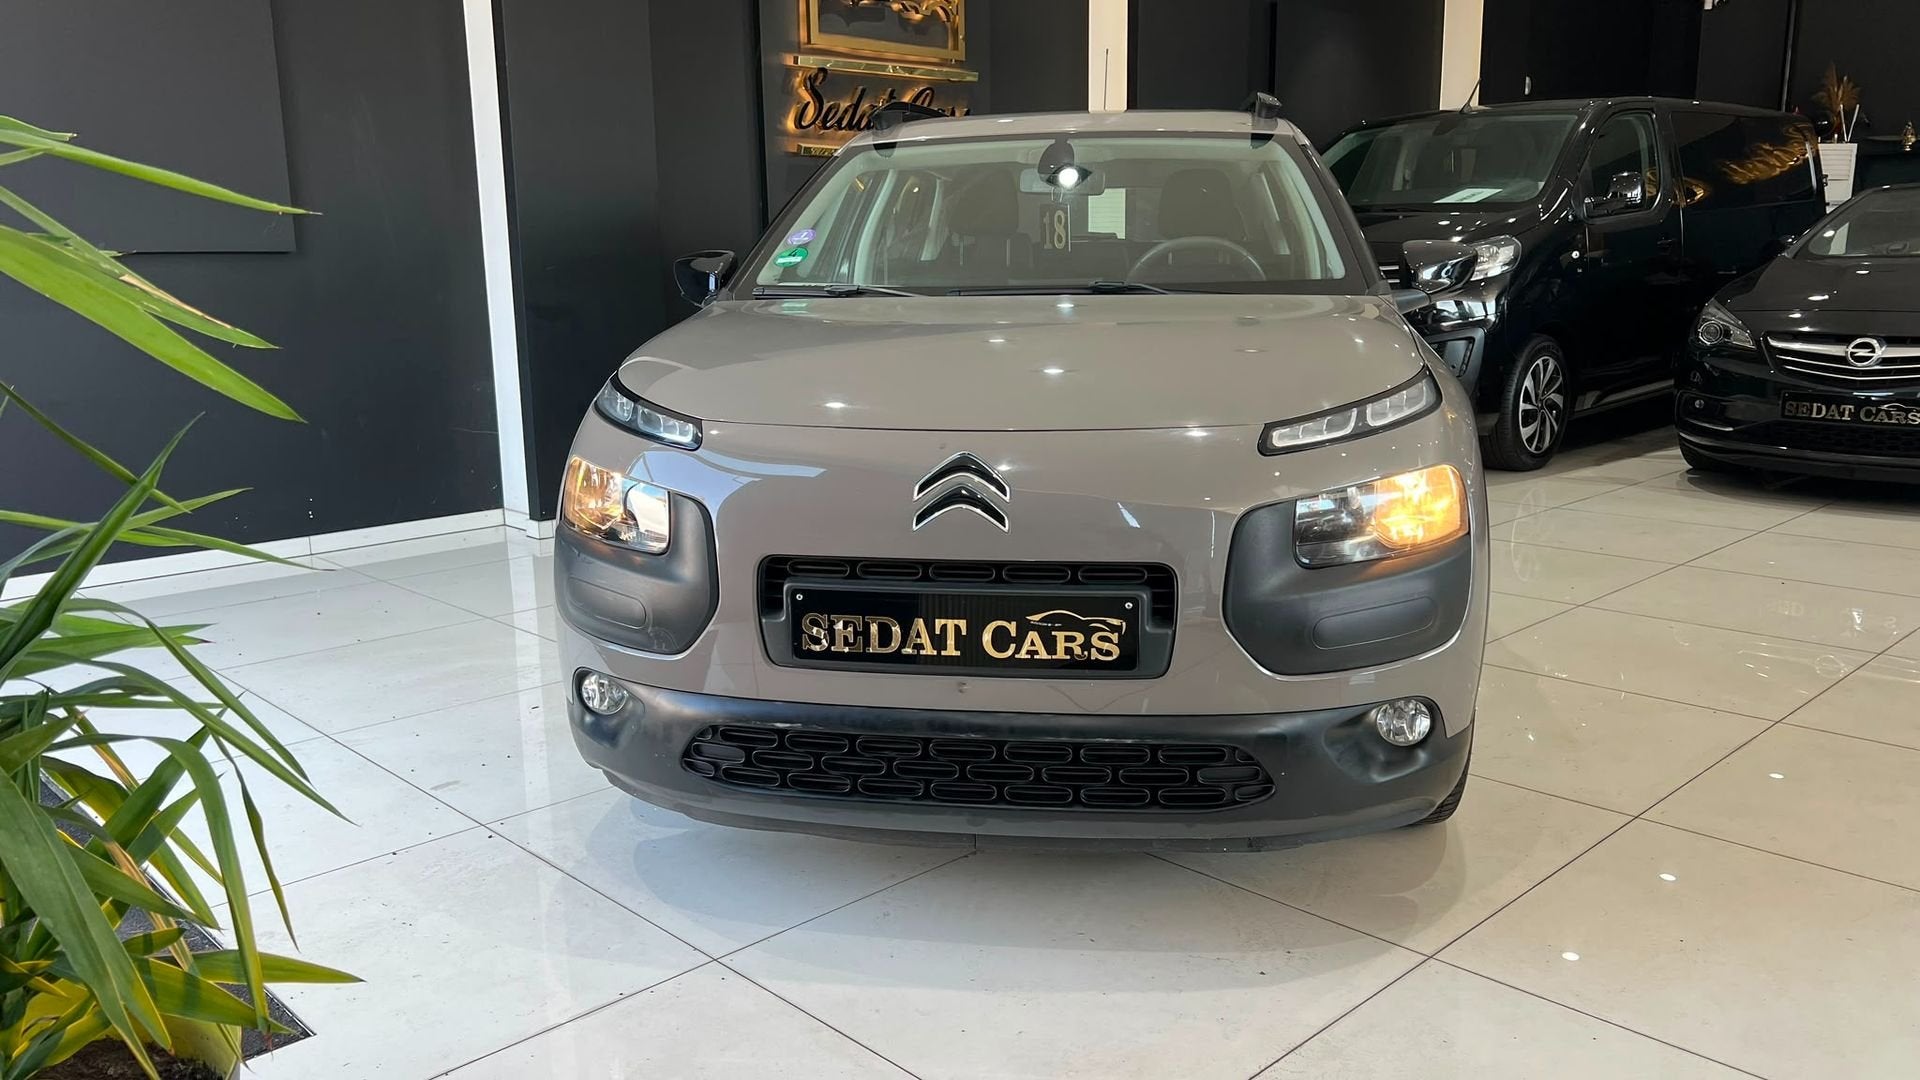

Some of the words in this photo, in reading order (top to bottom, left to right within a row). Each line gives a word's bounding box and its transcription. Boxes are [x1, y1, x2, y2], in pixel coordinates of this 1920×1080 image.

[1043, 210, 1066, 249] 18
[1784, 401, 1855, 420] SEDAT
[1860, 406, 1920, 424] CARS
[802, 613, 967, 656] SEDAT
[982, 620, 1120, 661] CARS
